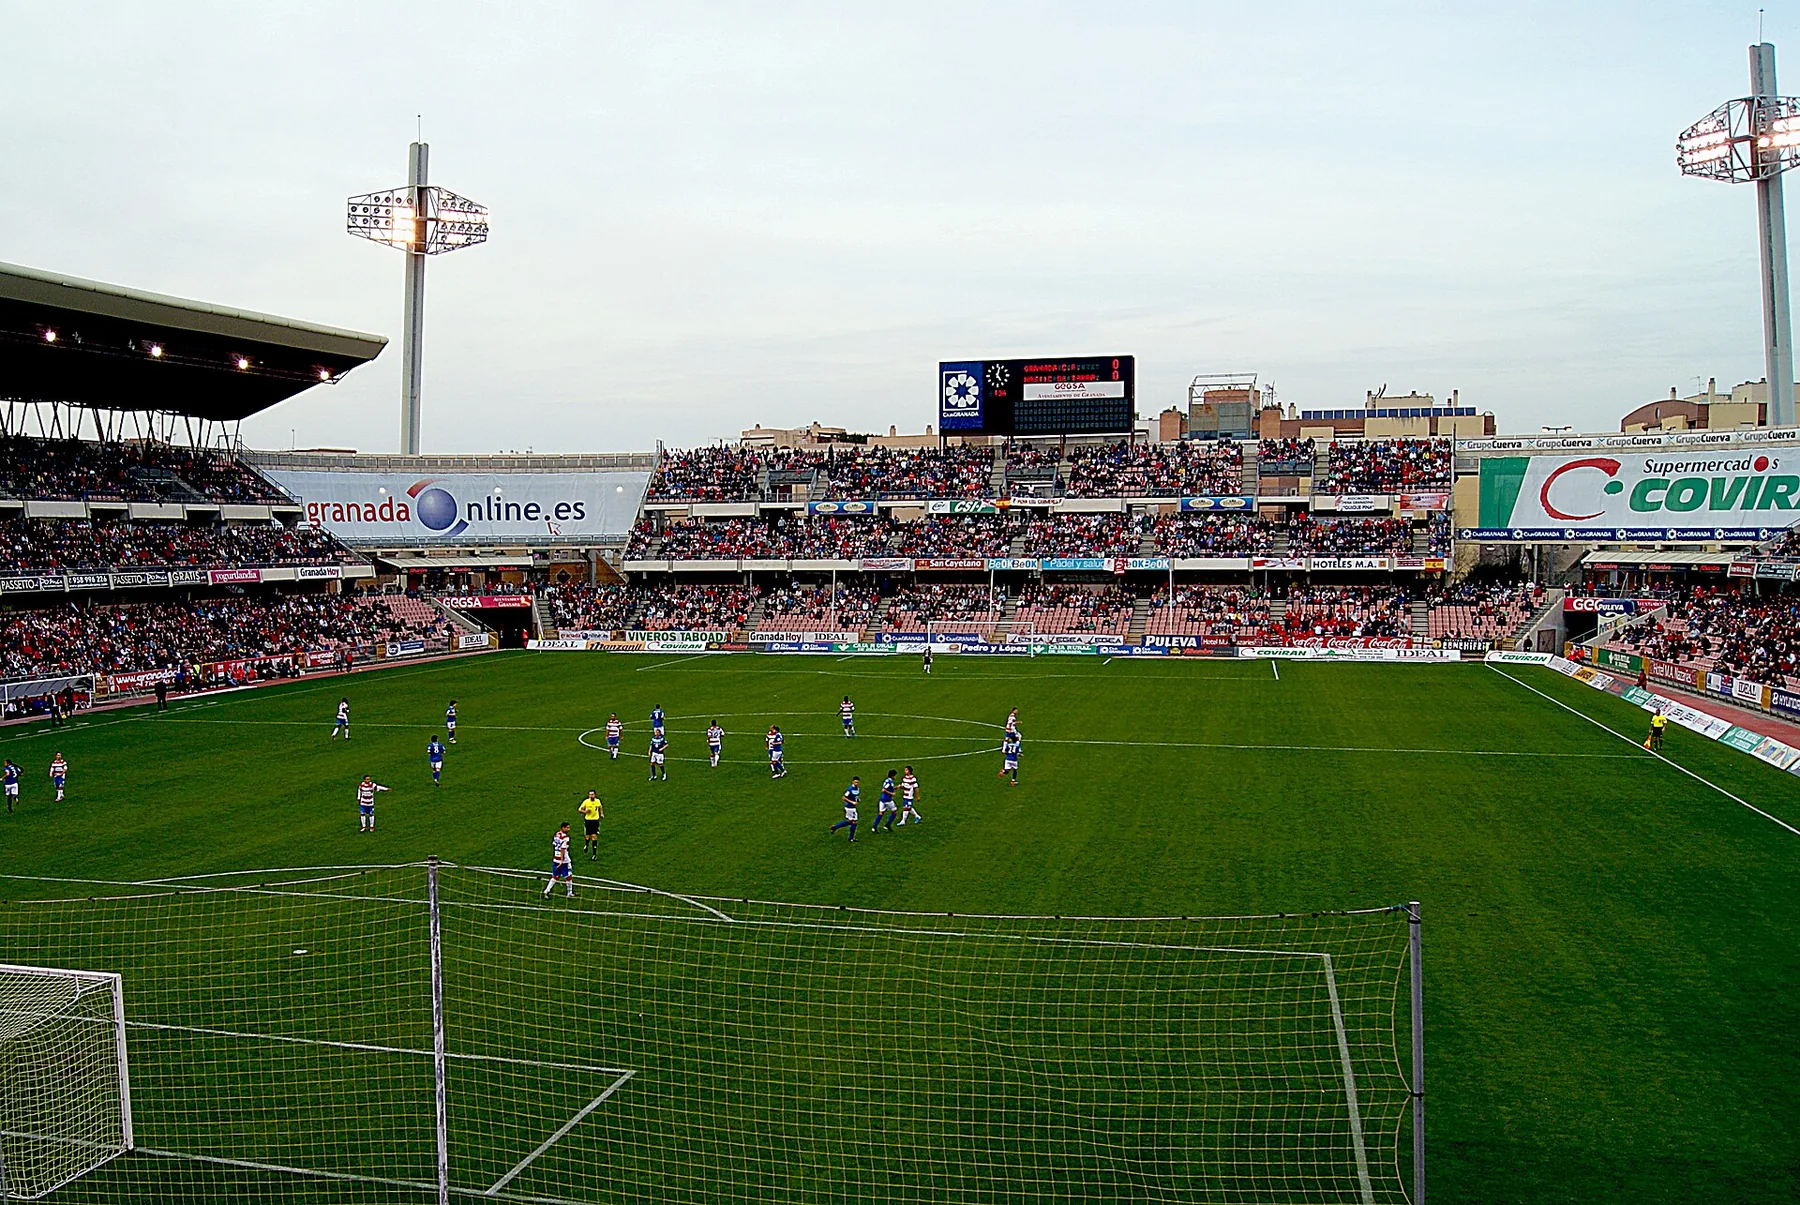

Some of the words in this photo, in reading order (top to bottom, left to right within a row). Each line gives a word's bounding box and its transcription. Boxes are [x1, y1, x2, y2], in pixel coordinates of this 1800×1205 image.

[1112, 359, 1120, 370] 0
[1112, 370, 1120, 380] 0
[1606, 436, 1662, 447] GrupoCuerva
[1676, 434, 1731, 446] GrupoCuerva
[1744, 430, 1796, 443] GrupoCuerva
[1467, 440, 1522, 451] GrupoCuerva
[1536, 438, 1592, 449] GrupoCuerva
[1643, 454, 1780, 476] Supermercados
[1629, 475, 1800, 512] COVIR
[944, 560, 982, 568] Cayetano
[1312, 560, 1353, 568] HOTELES
[1354, 560, 1377, 568] M.A.
[172, 571, 200, 581] GRATIS
[215, 569, 257, 582] yogurtlandia
[300, 567, 327, 577] Granada
[327, 567, 340, 577] Hoy
[1, 579, 35, 590] PASSETTO
[113, 575, 142, 584] PASSETTO
[627, 632, 677, 641] VIVEROS
[750, 632, 784, 641] Granada
[785, 632, 802, 643] Hoy
[1145, 636, 1198, 647] PULEVA
[961, 644, 989, 652] Pedro
[990, 645, 997, 653] y
[999, 644, 1027, 653] López
[1738, 681, 1757, 696] IDEAL
[12, 769, 17, 778] 3
